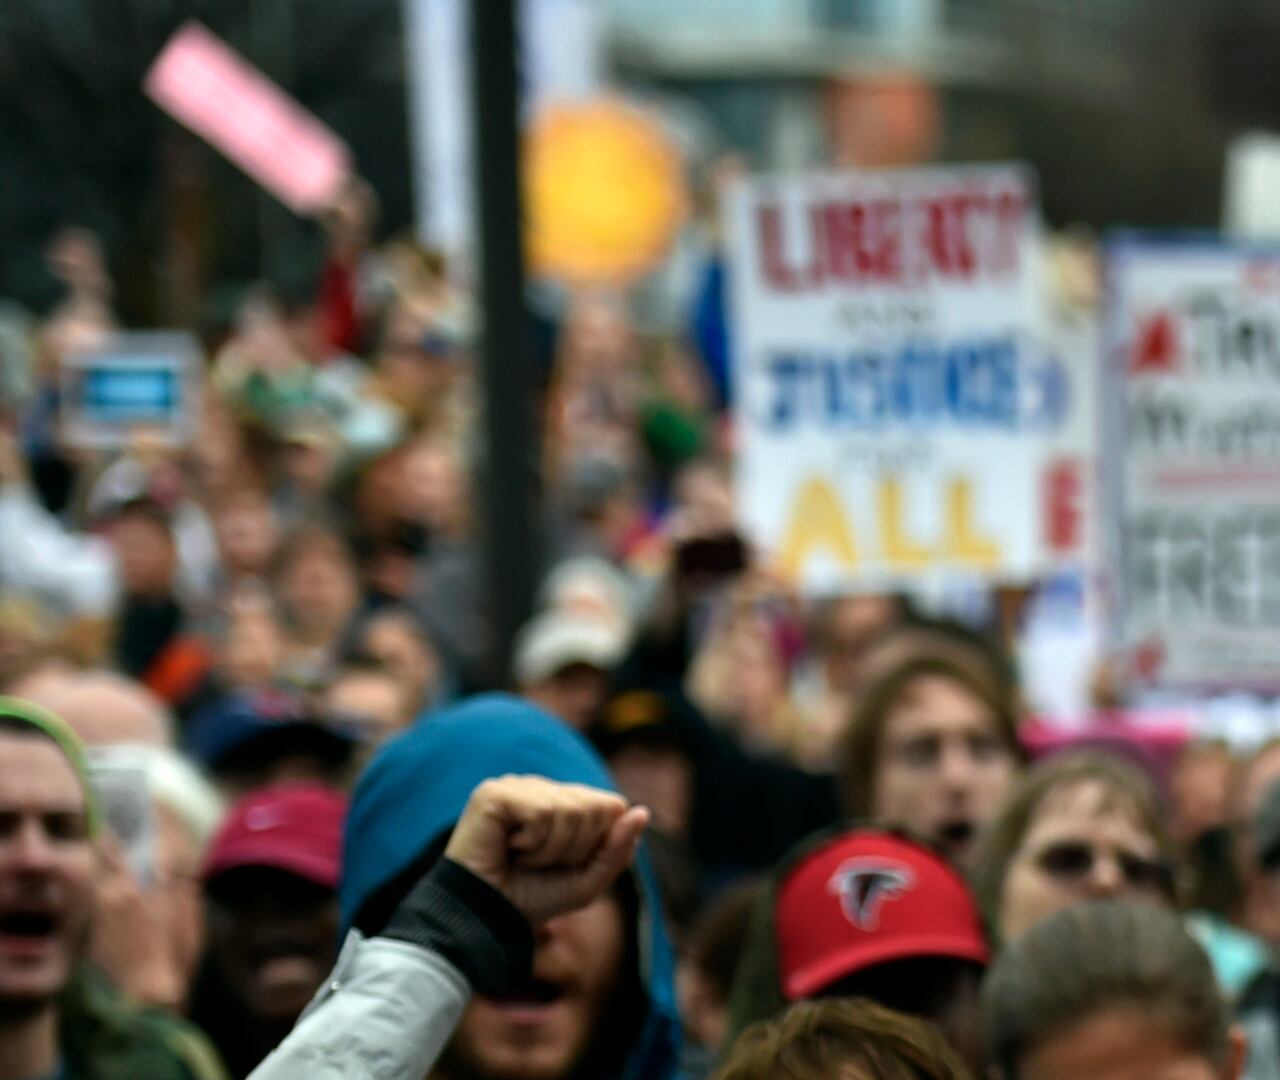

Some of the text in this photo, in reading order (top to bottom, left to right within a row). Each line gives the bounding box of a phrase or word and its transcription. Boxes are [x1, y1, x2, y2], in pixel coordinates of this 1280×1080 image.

[758, 184, 1026, 288] LIBERTY
[760, 338, 1030, 432] JUSTICE
[780, 472, 1006, 574] ALL
